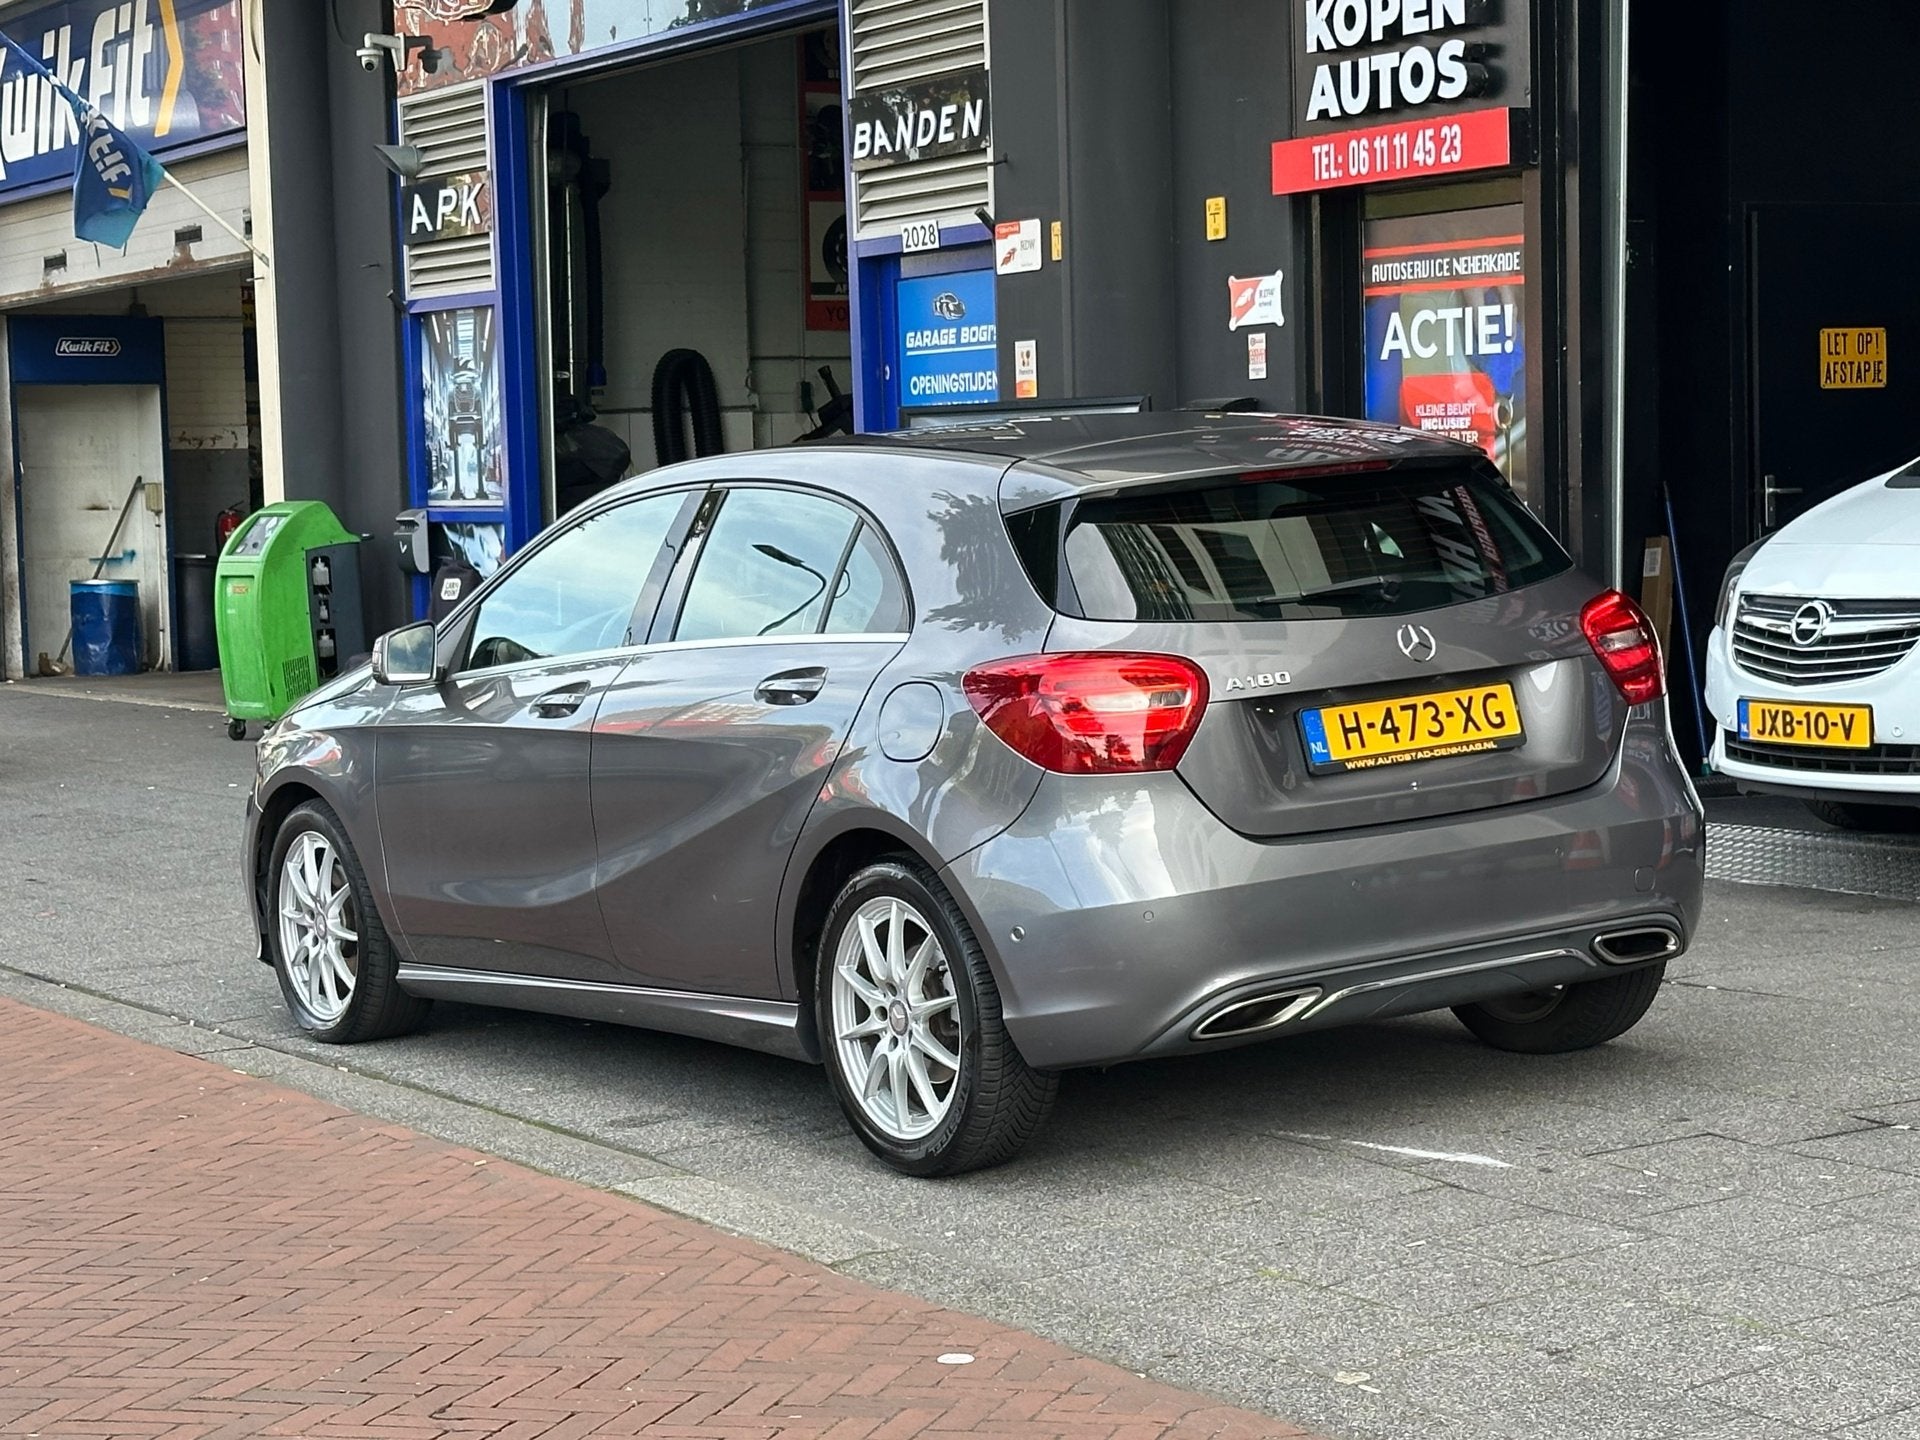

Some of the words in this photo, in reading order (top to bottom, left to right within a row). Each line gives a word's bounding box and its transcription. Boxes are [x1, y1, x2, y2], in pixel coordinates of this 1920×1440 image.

[1306, 0, 1466, 53] KOPEN
[1306, 39, 1468, 121] AUTOS
[853, 99, 983, 159] BANDEN
[1312, 143, 1343, 181] TEL:
[1349, 137, 1369, 176] 06
[1373, 134, 1389, 173] 11
[1393, 131, 1409, 170] 11
[1413, 128, 1436, 168] 45
[1440, 123, 1463, 164] 23
[410, 182, 484, 235] APK
[902, 224, 937, 251] 2028
[1371, 257, 1450, 283] AUTOSERVICE
[1452, 251, 1521, 276] NEHERKADE
[906, 327, 957, 349] GARAGE
[1379, 303, 1514, 361] ACTIE!
[1827, 332, 1849, 356] LET
[1857, 331, 1880, 355] OP!
[1824, 360, 1884, 385] AFSTAPJE
[1415, 403, 1446, 418] KLEINE
[1447, 402, 1476, 415] BEURT
[1421, 417, 1472, 431] INCLUSIEF
[1310, 742, 1328, 754] NL
[1338, 692, 1507, 751] H-473-XG
[1757, 708, 1855, 741] JXB-10-V
